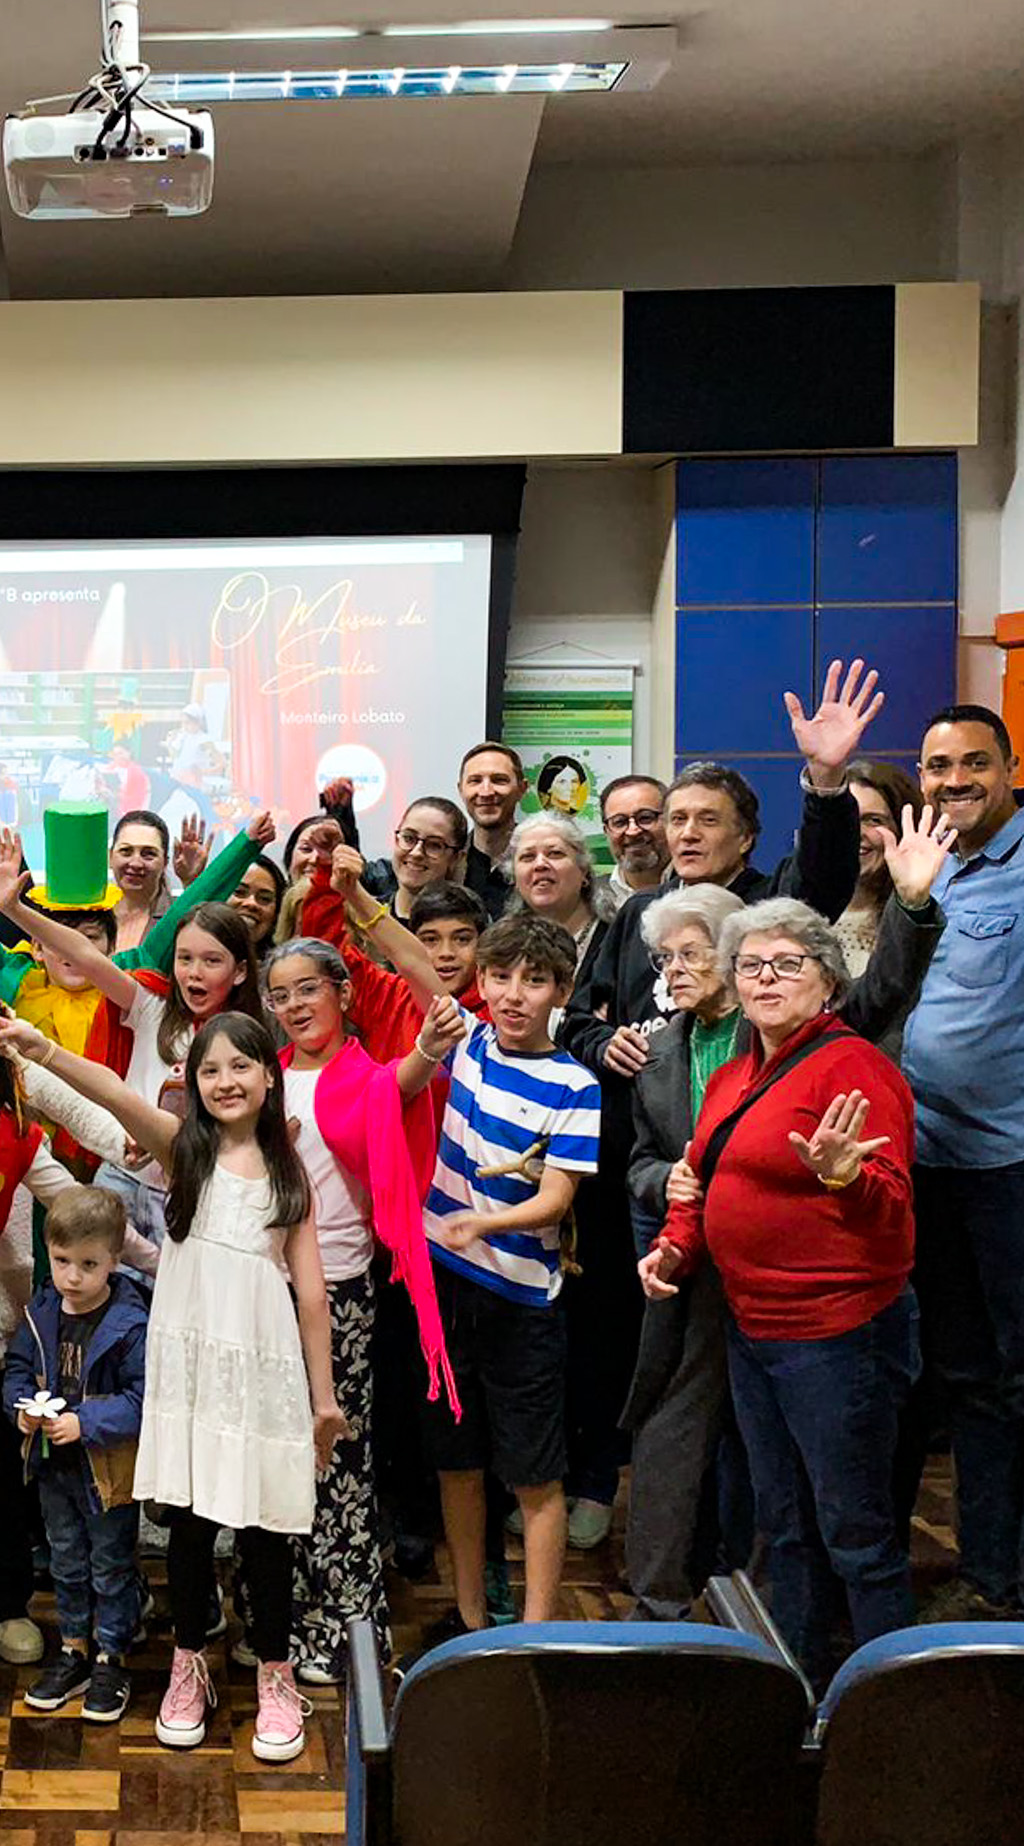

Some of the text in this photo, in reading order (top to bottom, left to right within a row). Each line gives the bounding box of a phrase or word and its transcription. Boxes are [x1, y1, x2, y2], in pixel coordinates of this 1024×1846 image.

[21, 586, 101, 605] apresenta
[211, 571, 427, 649] O Museu da
[279, 706, 405, 726] Monteiro Lobato
